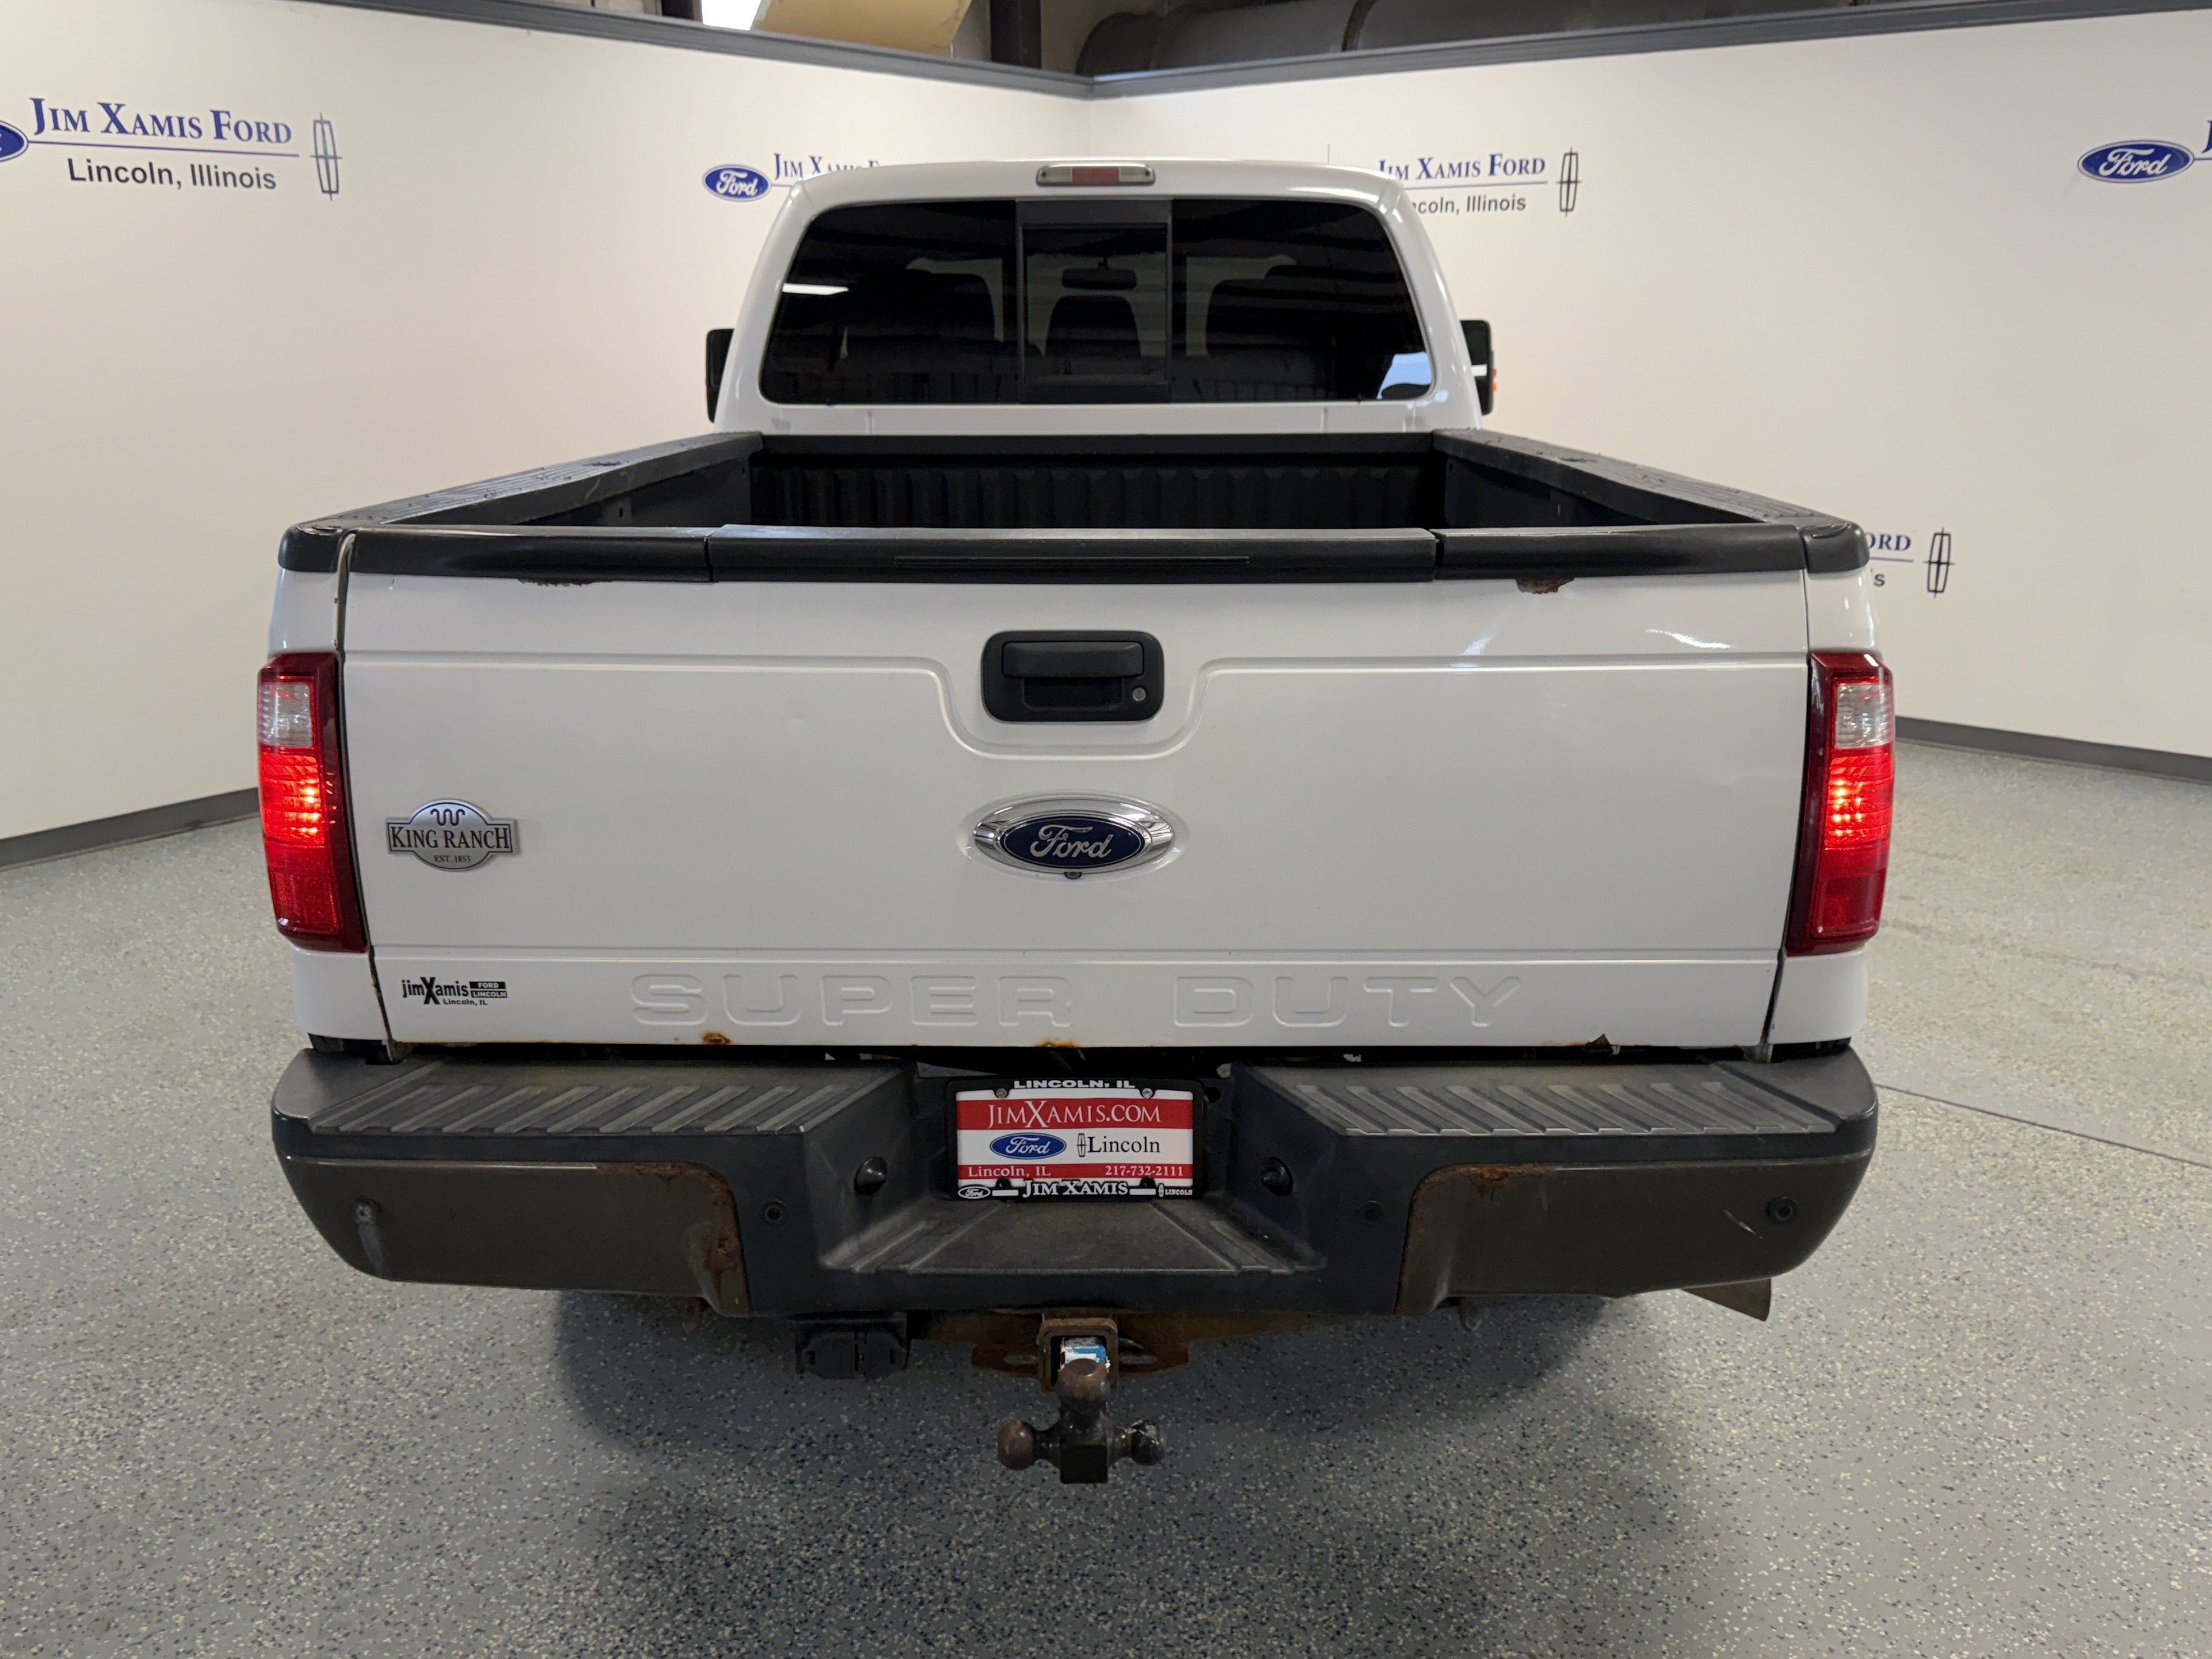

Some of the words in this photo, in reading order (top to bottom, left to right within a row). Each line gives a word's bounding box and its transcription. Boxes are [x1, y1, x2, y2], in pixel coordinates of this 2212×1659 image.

[30, 98, 90, 136] JIM
[97, 102, 202, 139] XAMIS
[210, 109, 291, 144] FORD
[774, 153, 804, 180] JIM
[1415, 157, 1481, 180] XAMIS
[1488, 154, 1545, 176] FORD
[2099, 148, 2171, 176] Ford
[67, 158, 182, 189] Lincoln,
[191, 163, 276, 189] Illinois
[716, 170, 758, 196] Ford
[1466, 194, 1526, 213] Illinois
[391, 827, 438, 848] KING
[443, 828, 510, 849] RANCH
[1030, 824, 1111, 858] Ford
[631, 973, 1073, 1026] SUPER
[1173, 976, 1522, 1028] DUTY
[1014, 1080, 1109, 1088] LINCOLN,
[1116, 1080, 1136, 1088] IL
[1006, 1136, 1050, 1154] Ford
[1087, 1136, 1160, 1153] Lincoln
[968, 1166, 1030, 1177] Lincoln,
[1036, 1166, 1051, 1176] IL
[1105, 1165, 1183, 1176] 217-732-2111
[965, 1188, 984, 1198] Ford
[1022, 1180, 1059, 1198] JIM
[1062, 1180, 1128, 1195] XAMIS
